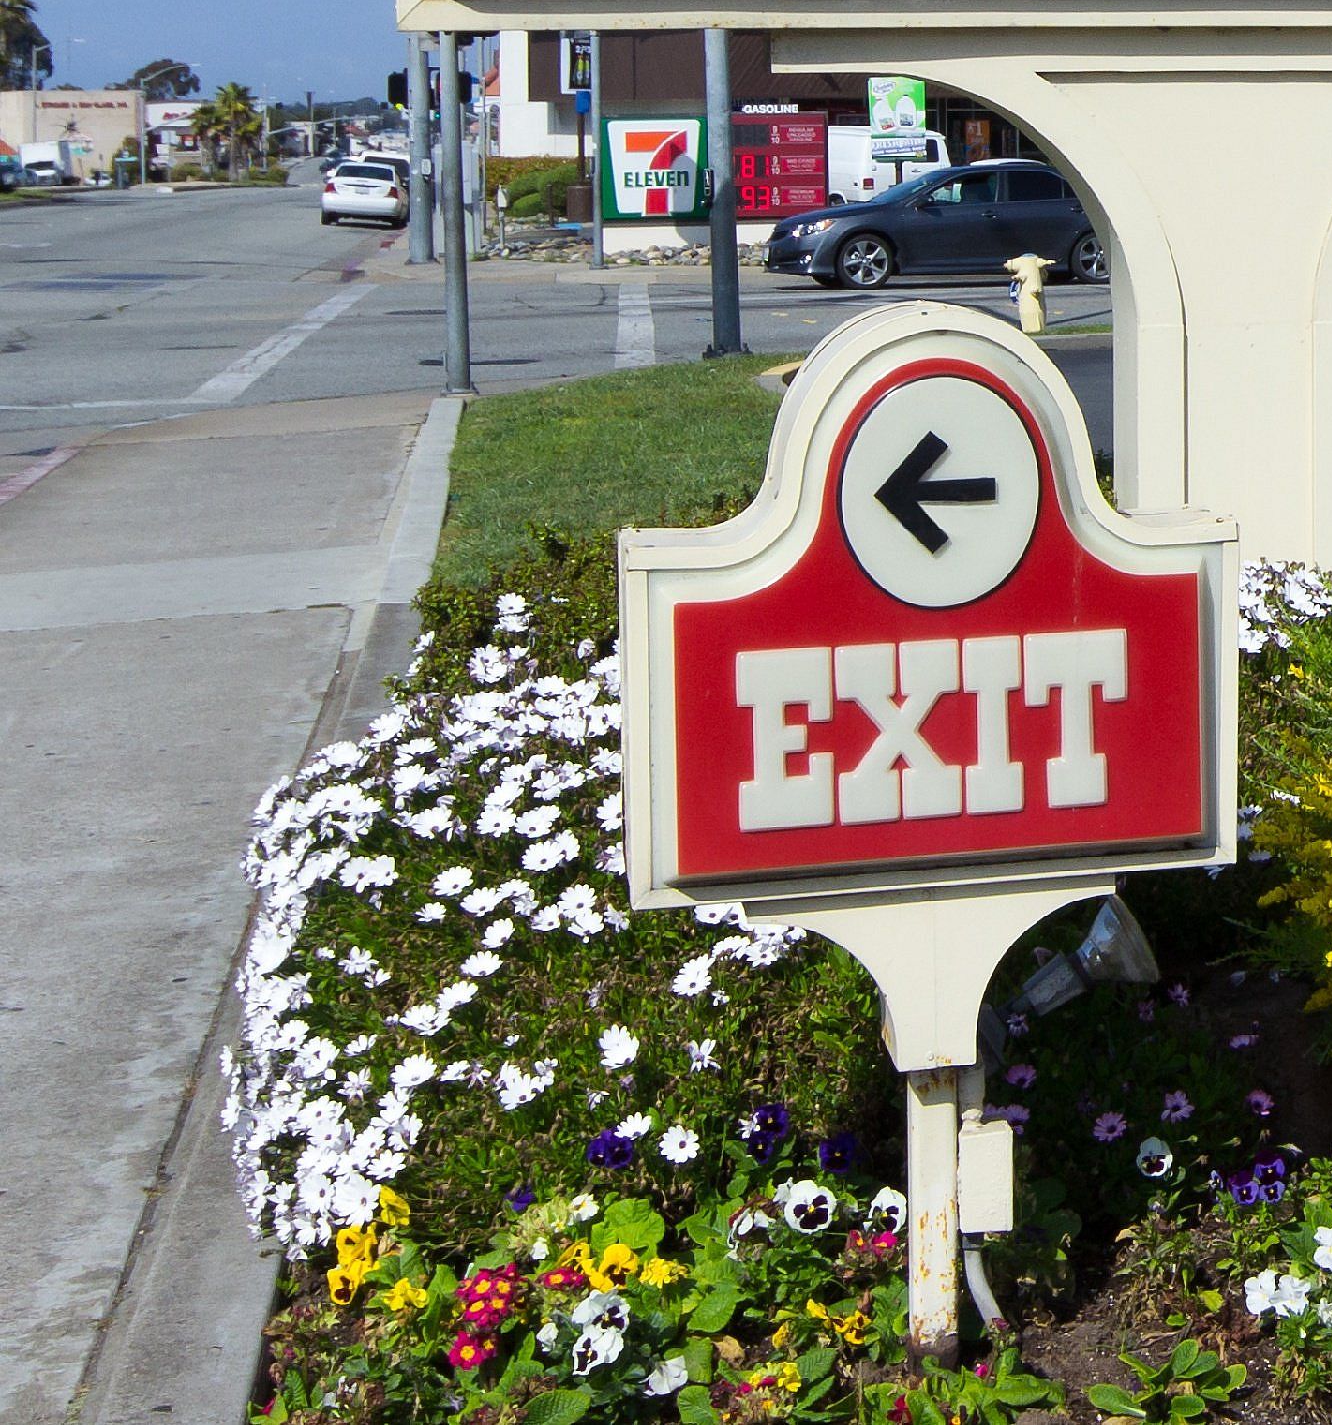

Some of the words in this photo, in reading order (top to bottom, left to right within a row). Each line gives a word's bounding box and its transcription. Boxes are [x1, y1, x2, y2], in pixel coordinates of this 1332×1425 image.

[742, 104, 799, 114] GASOLINE
[625, 130, 688, 216] 7
[735, 627, 1128, 833] EXIT
